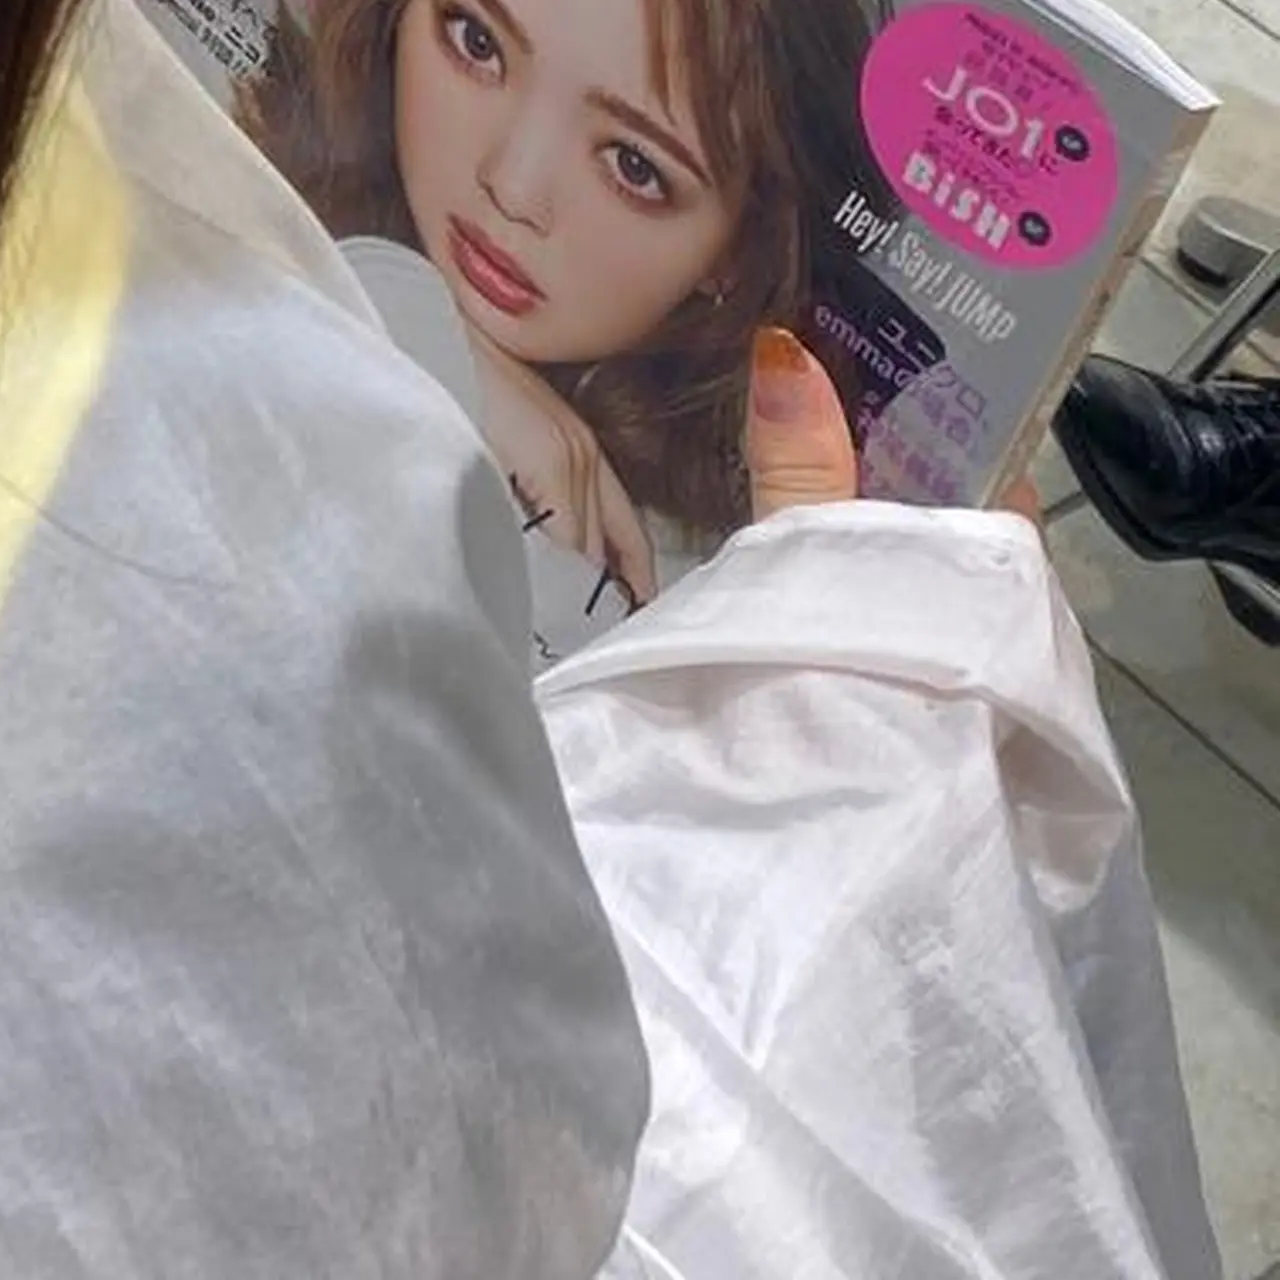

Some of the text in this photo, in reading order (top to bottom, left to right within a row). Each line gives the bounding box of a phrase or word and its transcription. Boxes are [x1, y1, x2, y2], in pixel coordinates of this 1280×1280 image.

[920, 65, 1045, 162] JO1
[901, 150, 1011, 250] BiSH
[833, 190, 1018, 341] Hey! Say! JUMP
